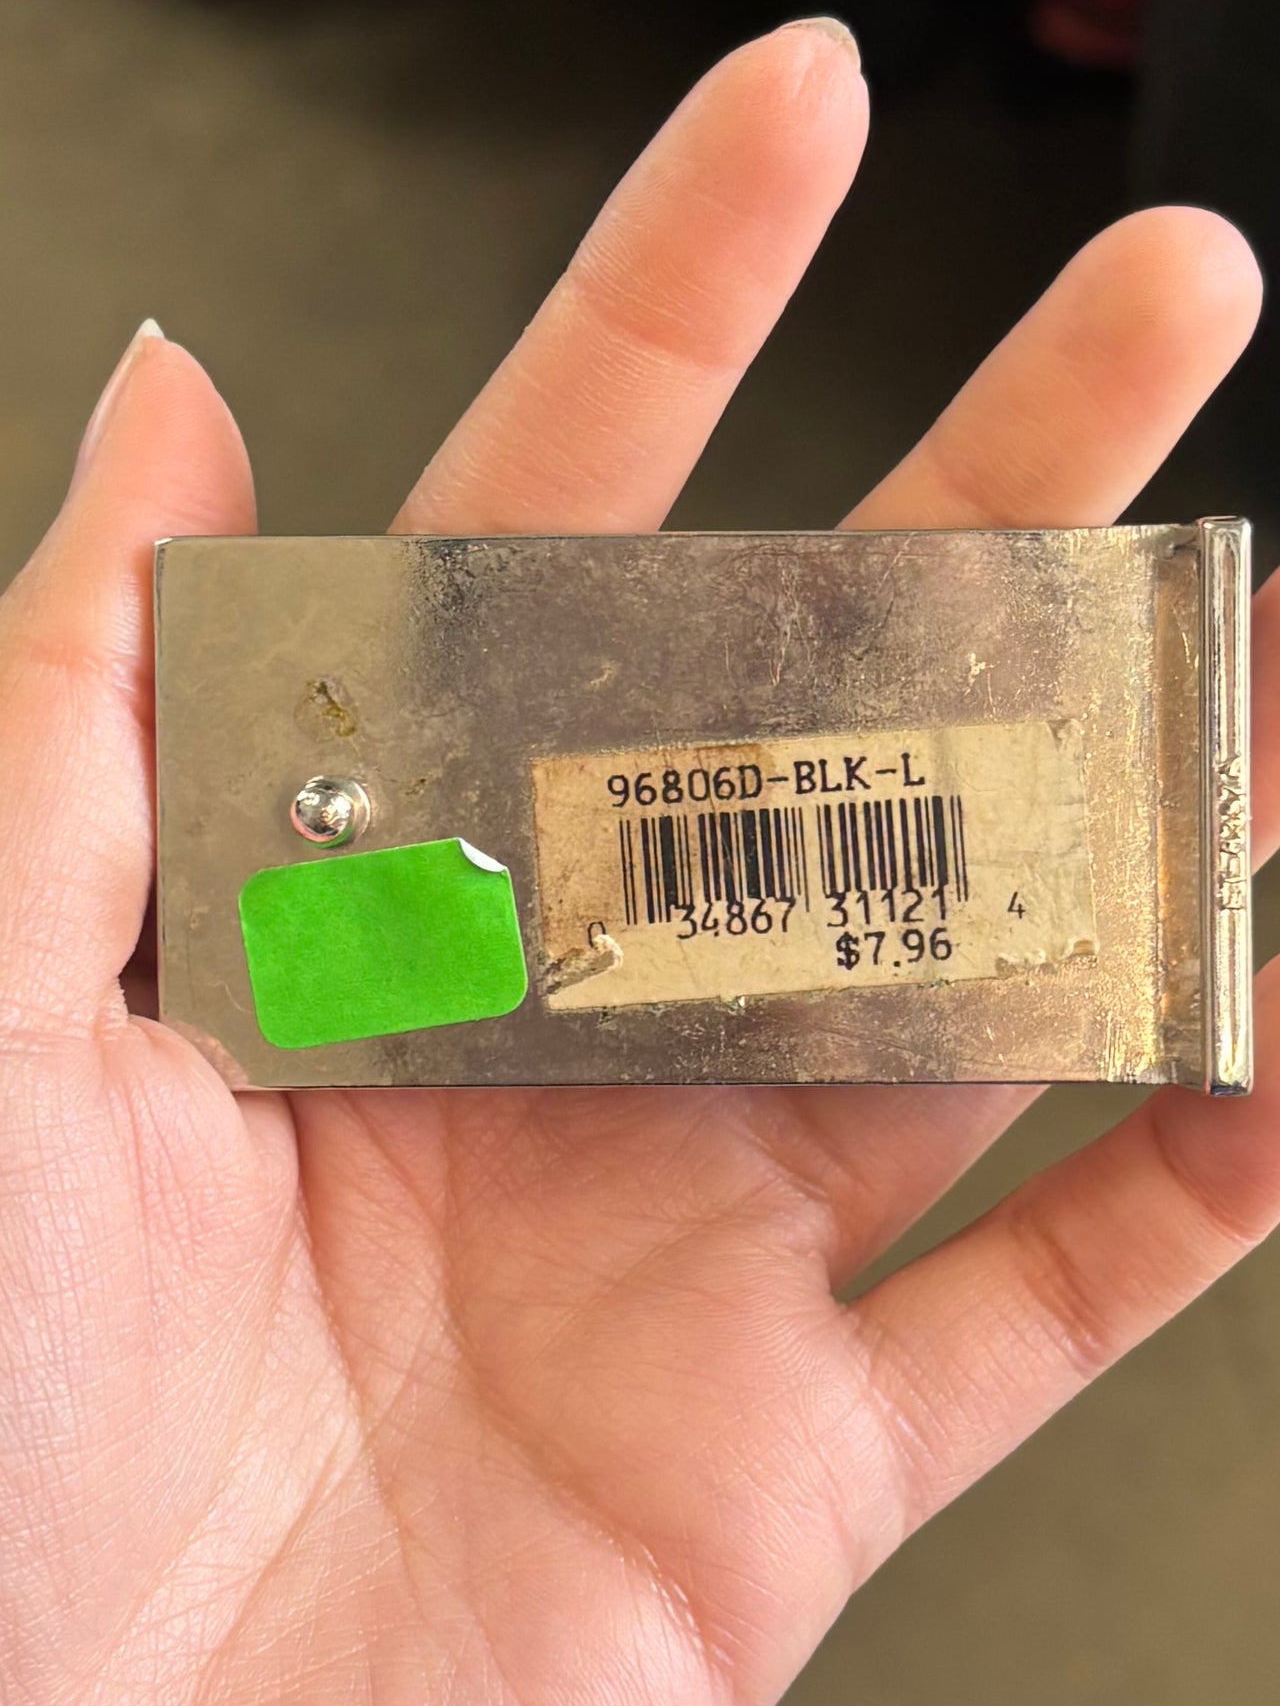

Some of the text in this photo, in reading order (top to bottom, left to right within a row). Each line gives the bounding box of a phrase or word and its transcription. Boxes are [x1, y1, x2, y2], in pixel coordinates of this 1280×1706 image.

[607, 752, 925, 807] 96806D-BLK-L
[674, 895, 797, 939] 34867
[825, 885, 947, 928] 31121
[1006, 891, 1026, 920] 4
[835, 927, 953, 971] $7.96
